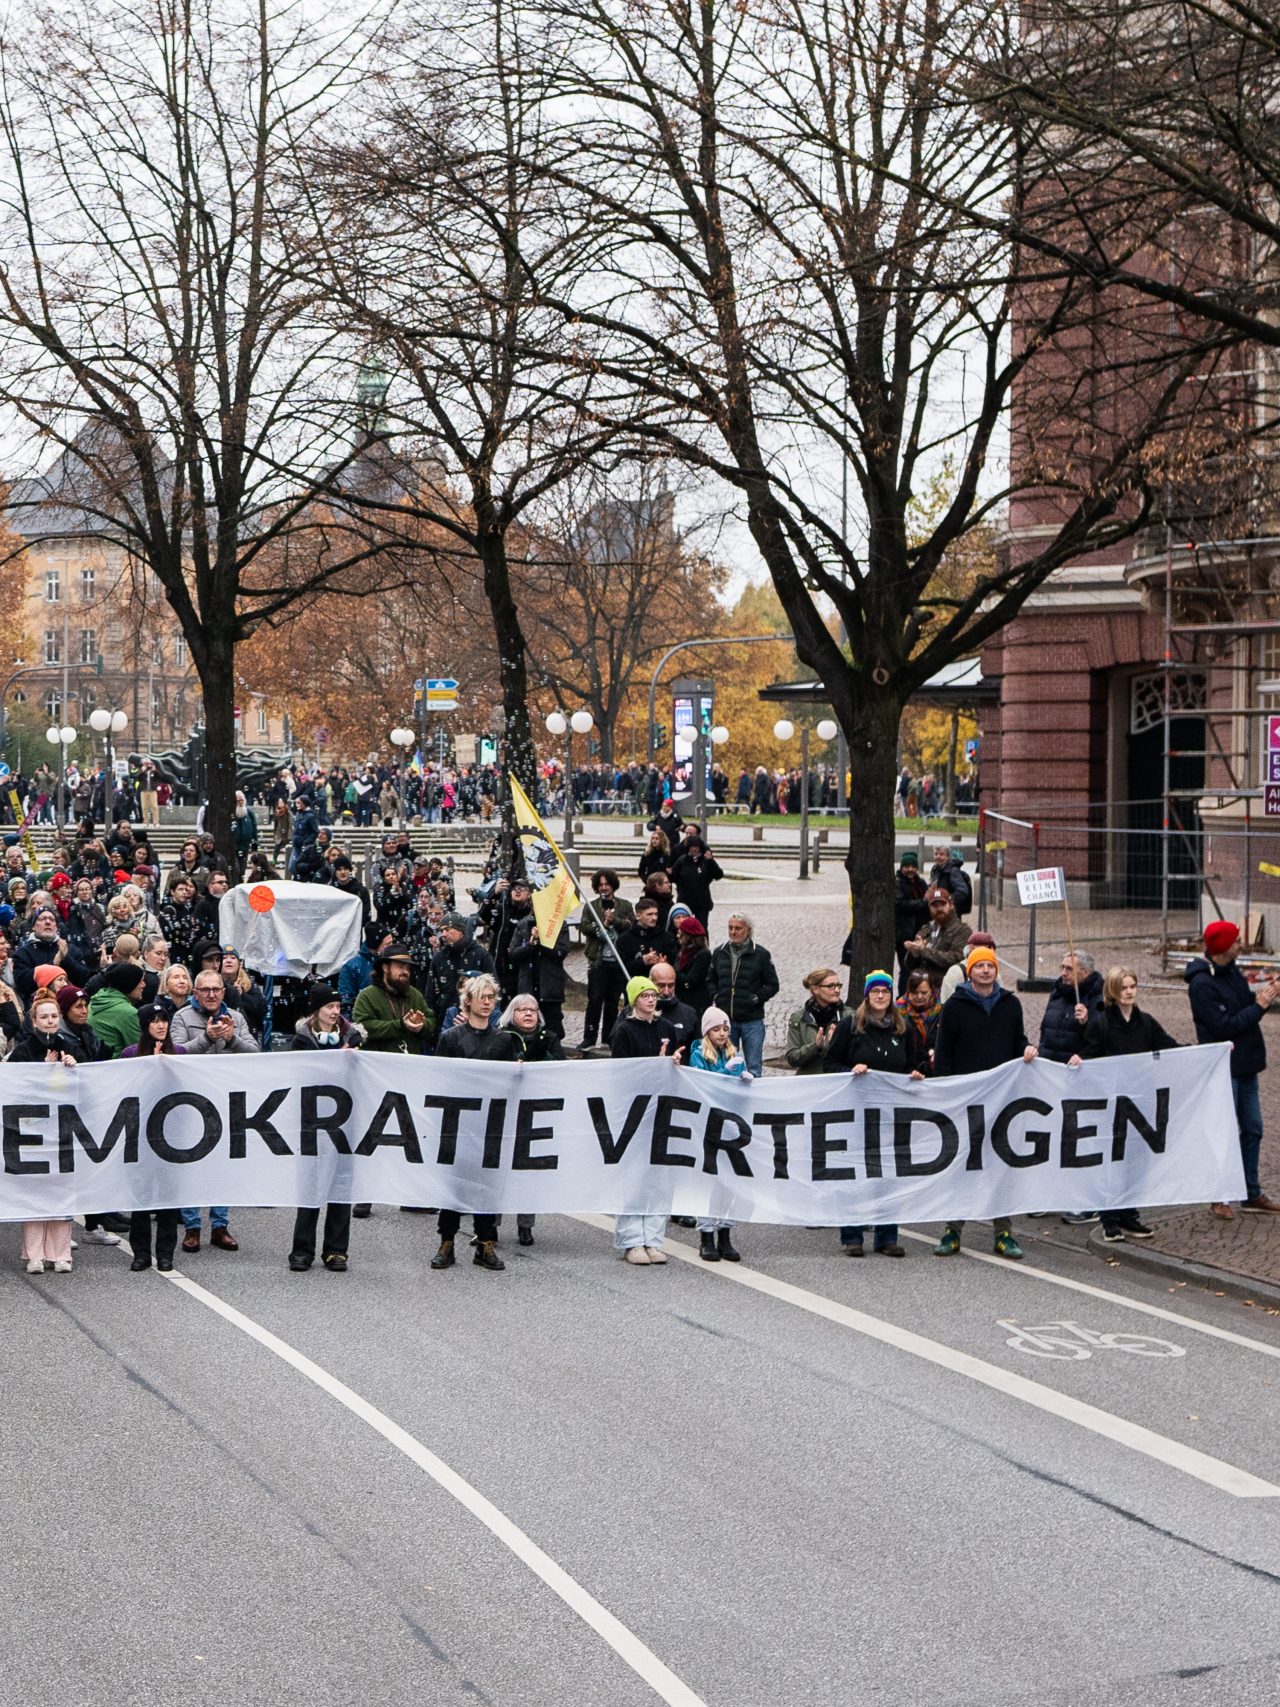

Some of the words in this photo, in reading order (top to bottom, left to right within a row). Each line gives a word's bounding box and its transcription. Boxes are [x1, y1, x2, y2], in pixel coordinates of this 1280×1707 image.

[1025, 881, 1057, 892] KEINE
[1027, 890, 1059, 901] CHANCE
[586, 1087, 1171, 1181] VERTEIDIGEN
